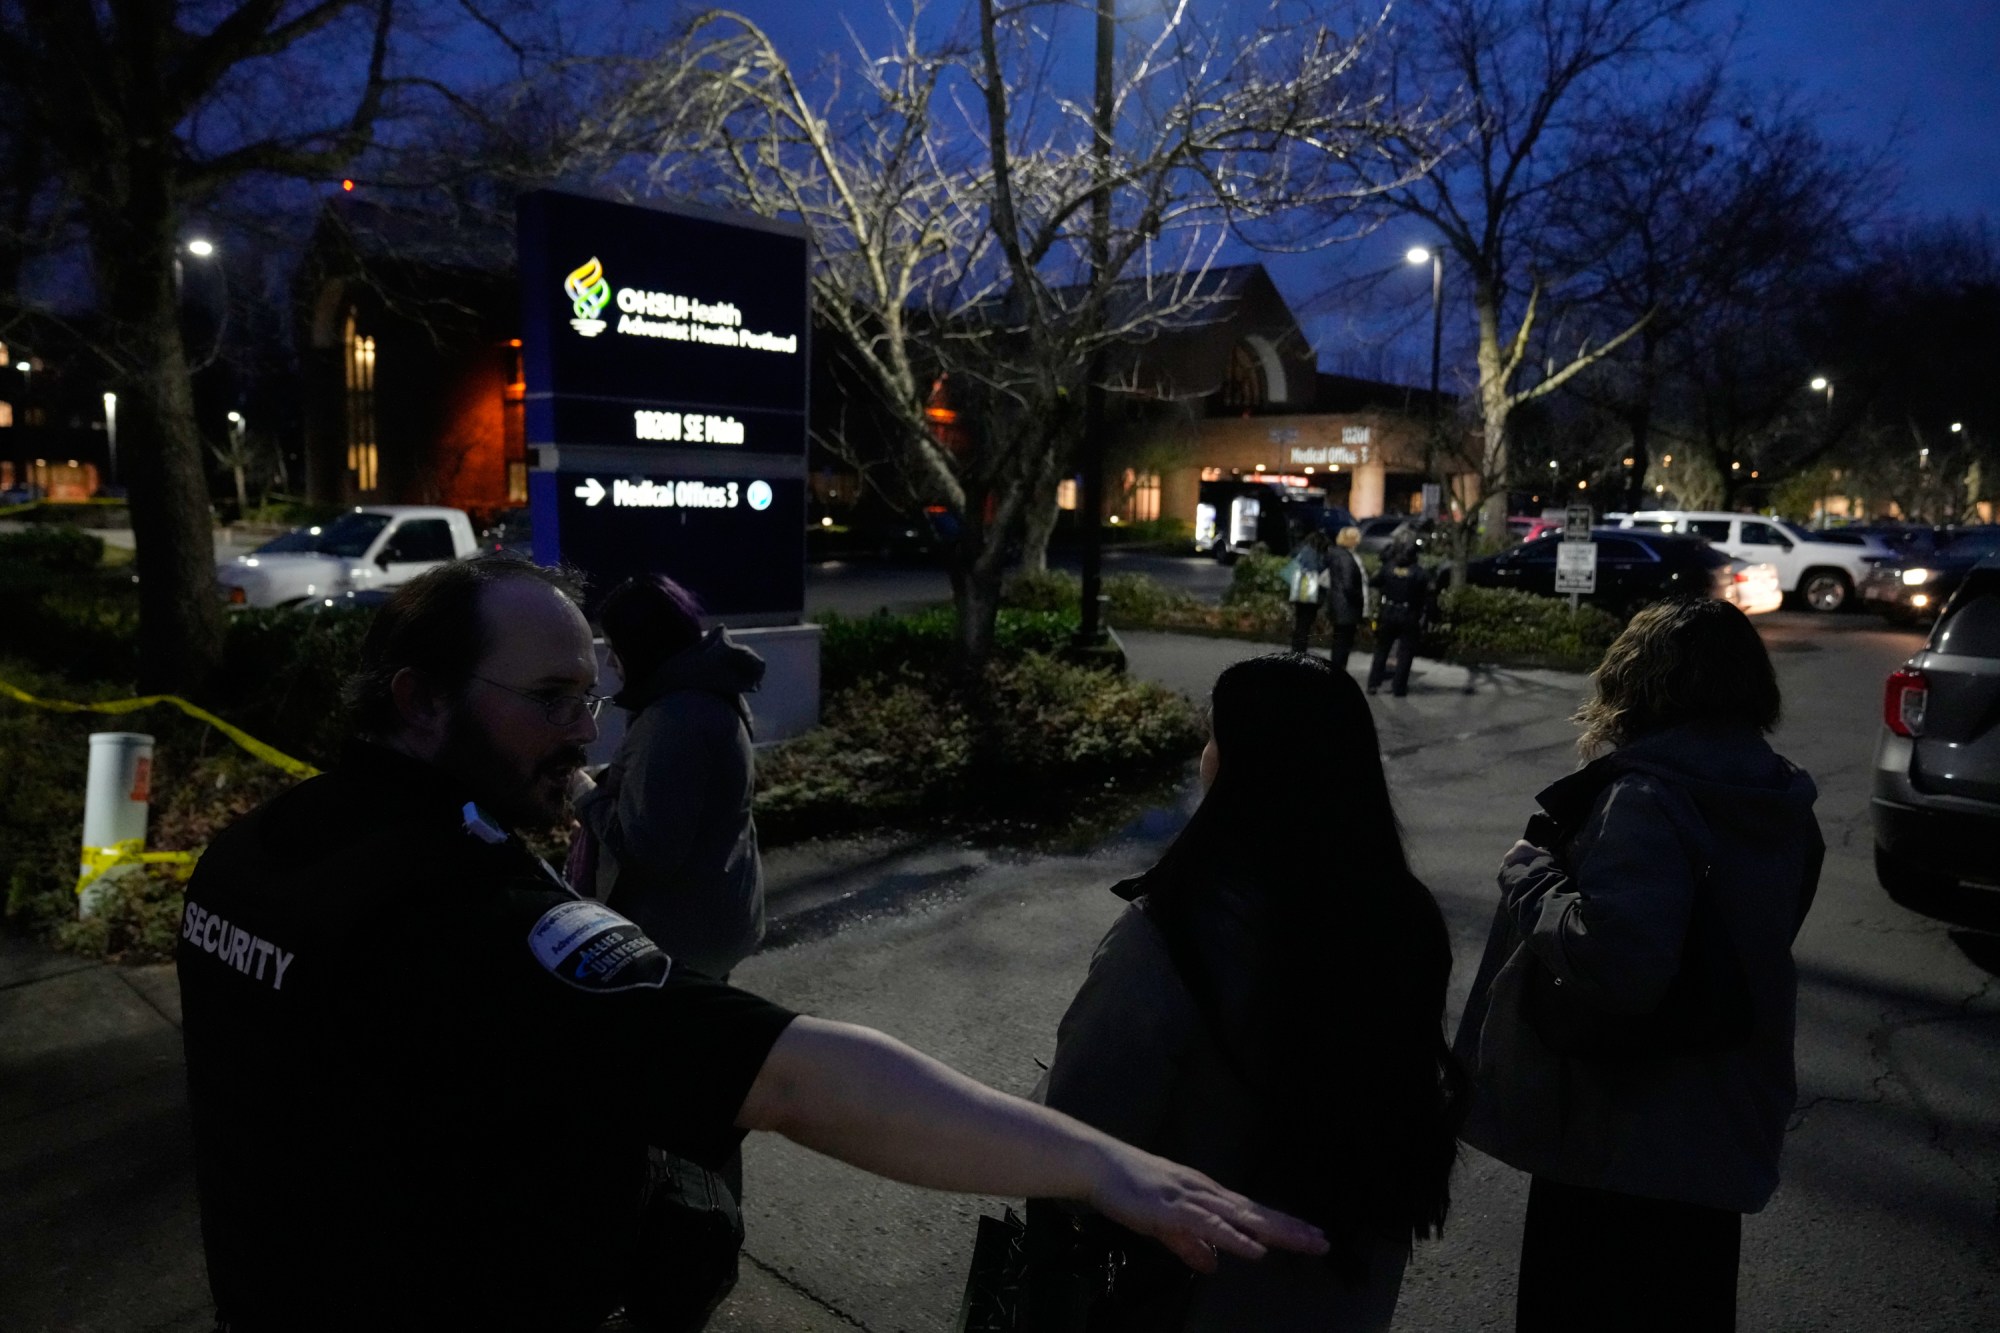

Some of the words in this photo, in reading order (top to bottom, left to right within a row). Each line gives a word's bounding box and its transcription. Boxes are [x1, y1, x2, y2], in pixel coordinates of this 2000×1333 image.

[617, 288, 682, 319] OHSU
[683, 413, 704, 442] SE
[613, 479, 674, 507] Medical
[727, 482, 739, 508] 3
[183, 901, 295, 990] SECURITY
